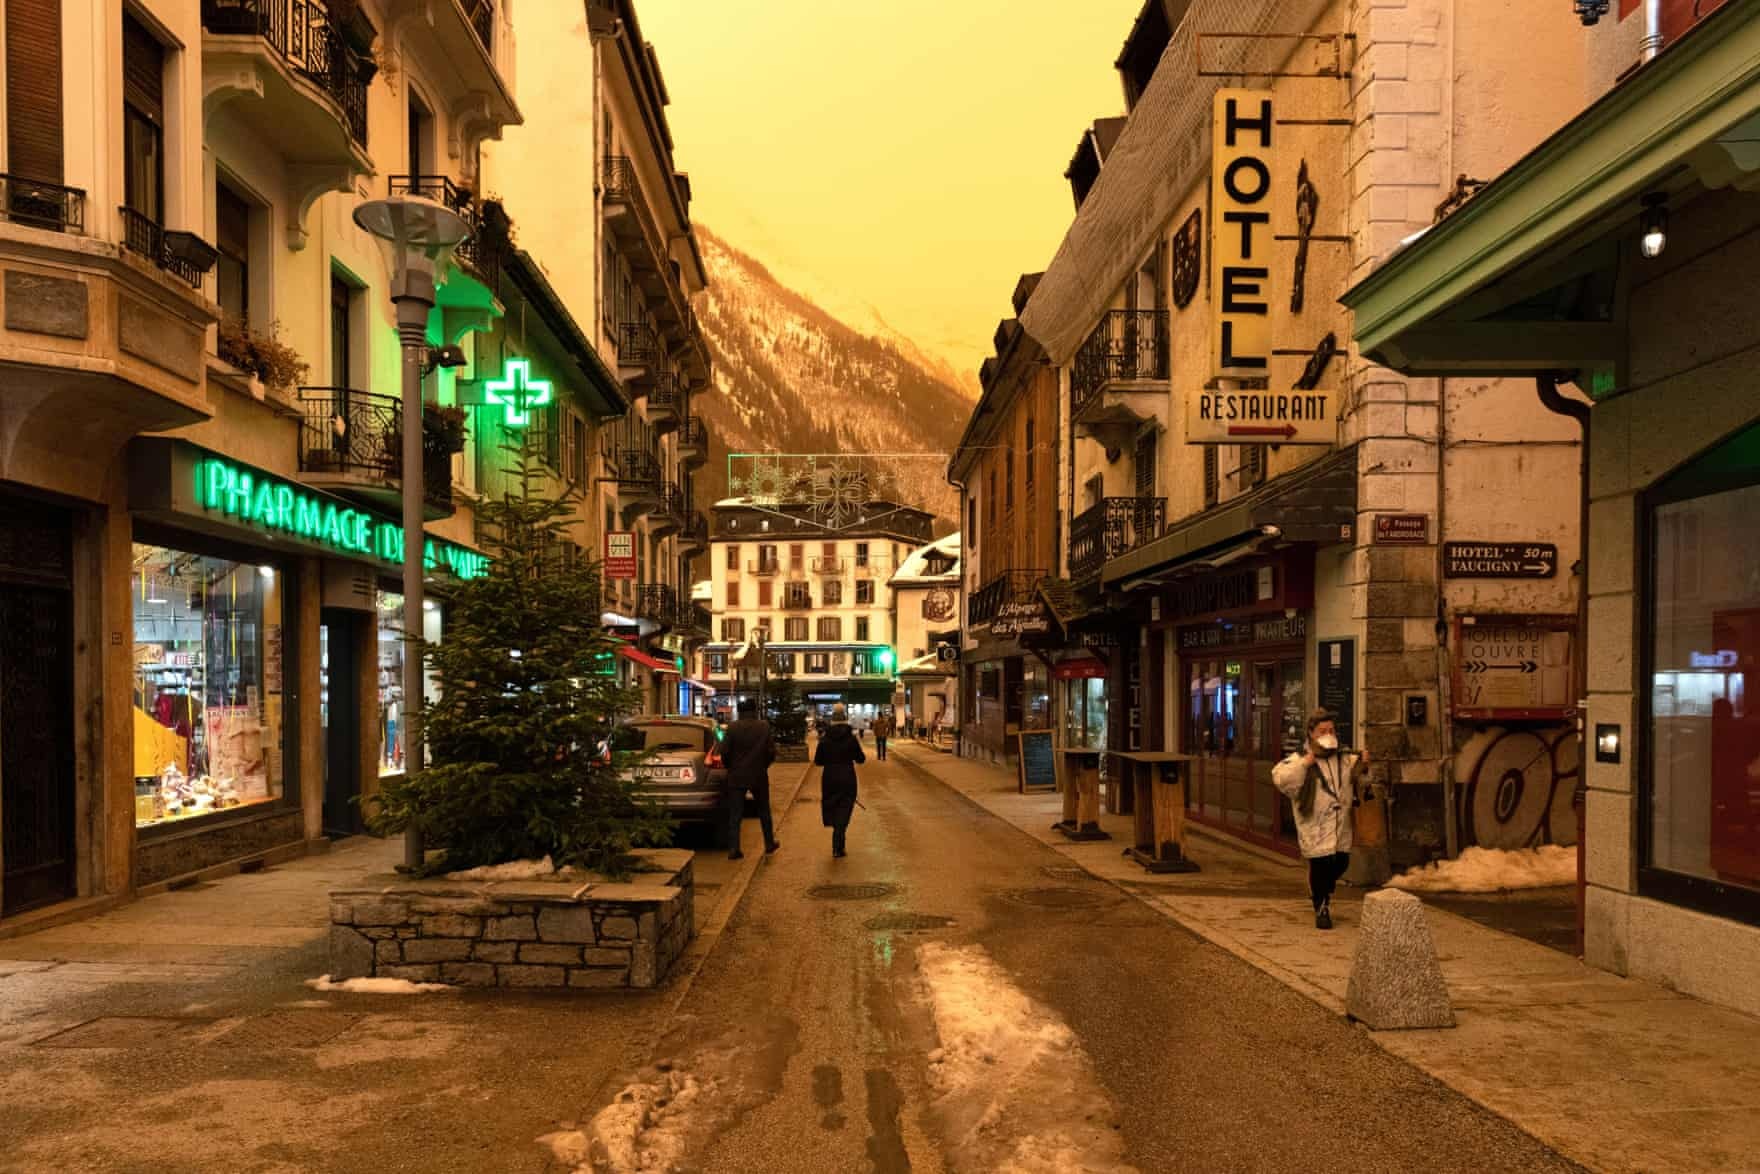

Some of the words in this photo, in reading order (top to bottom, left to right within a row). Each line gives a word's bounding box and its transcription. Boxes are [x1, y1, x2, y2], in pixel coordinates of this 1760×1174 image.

[1221, 99, 1272, 369] HOTEL
[1200, 395, 1328, 421] RESTAURANT
[203, 458, 373, 554] PHARMACIE
[1451, 547, 1503, 558] HOTEL
[1523, 548, 1540, 558] 50
[1451, 560, 1521, 572] FAUCIGNY
